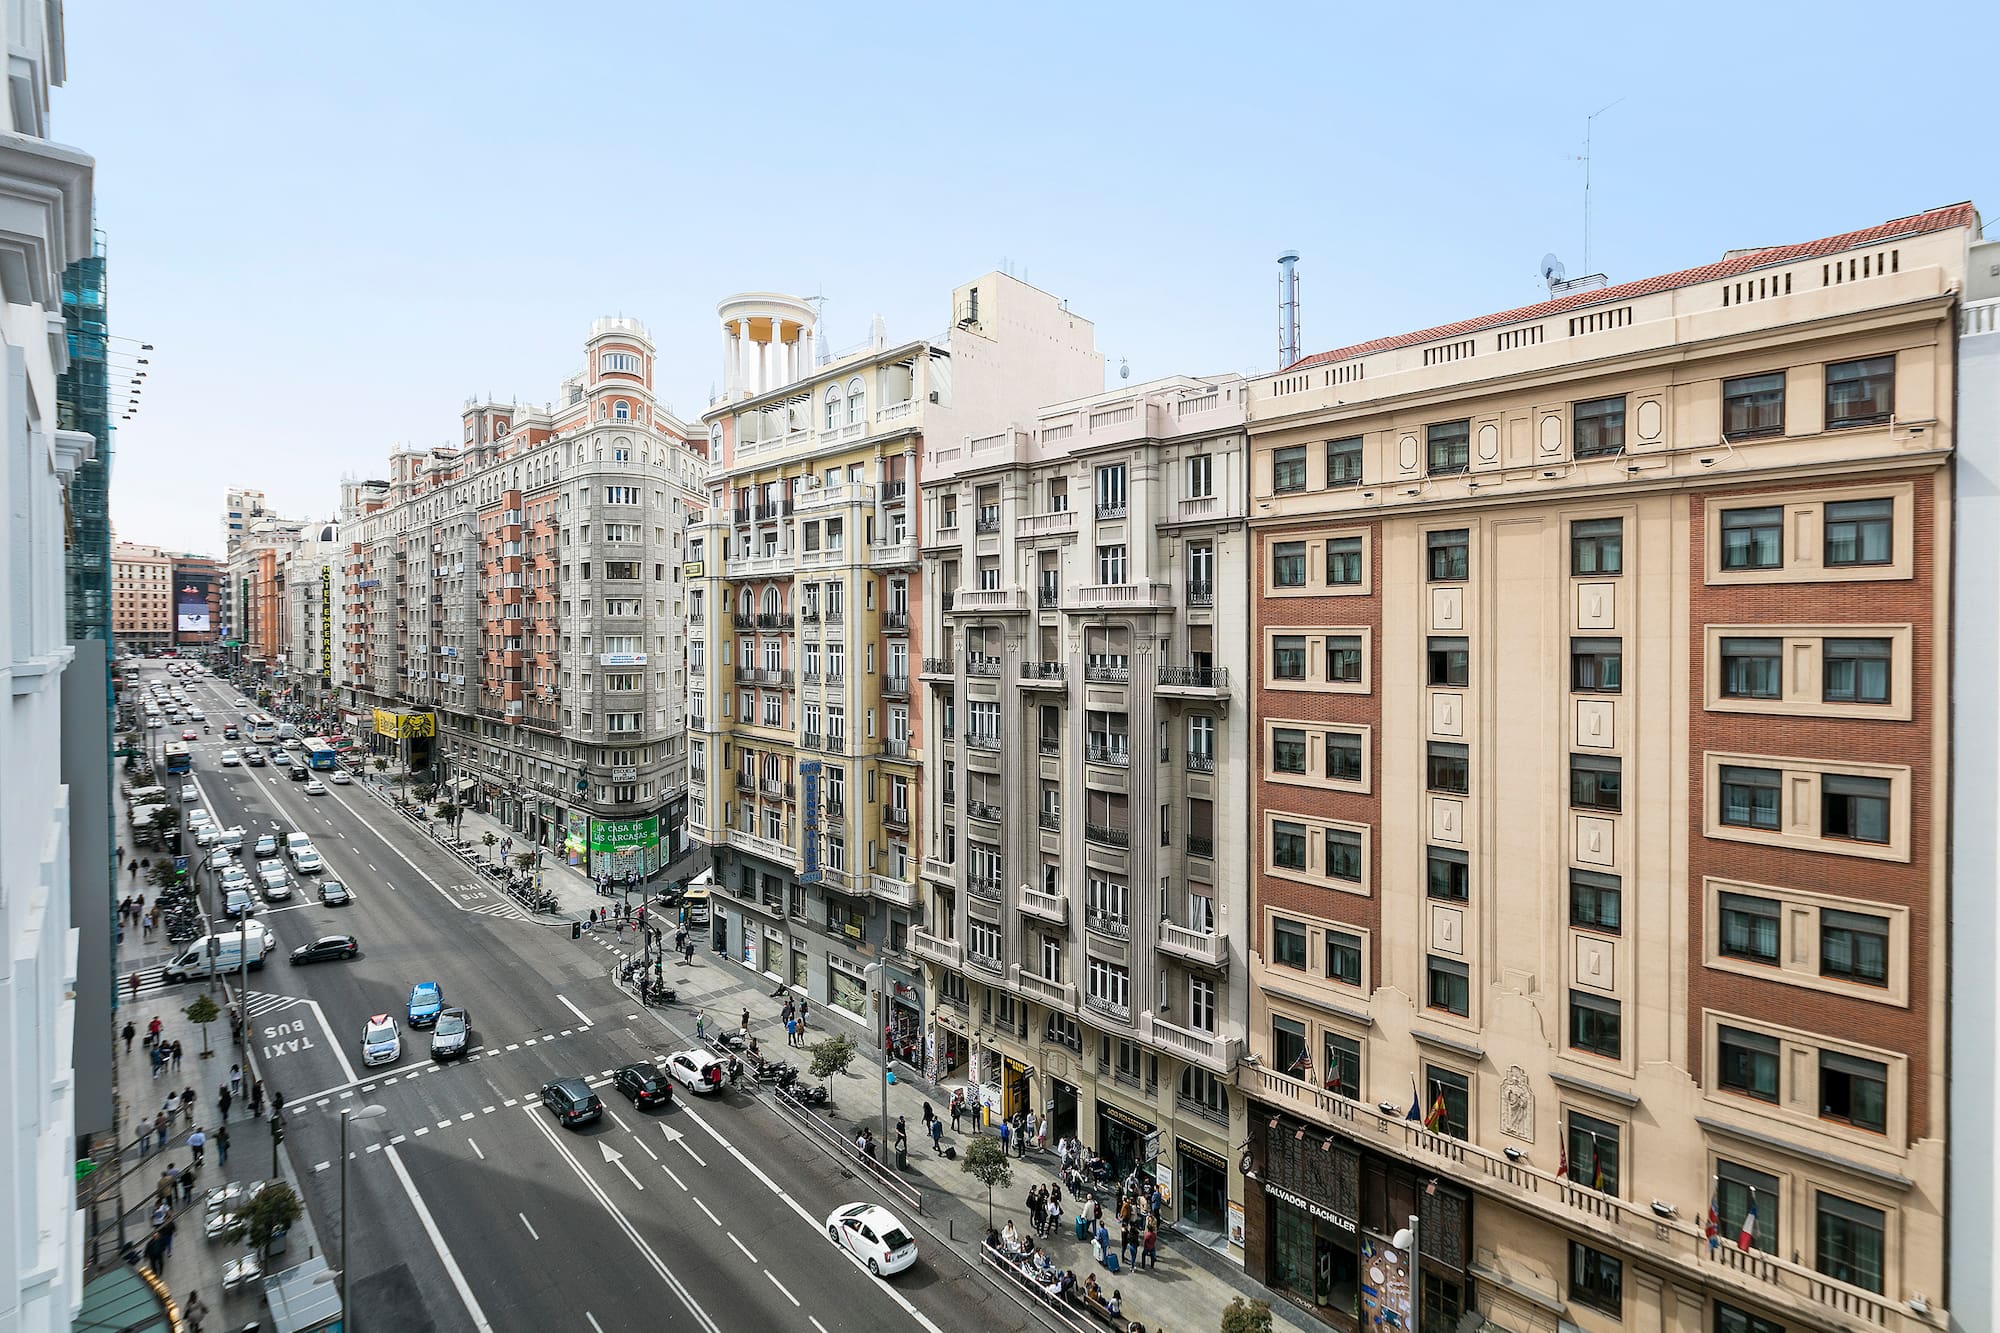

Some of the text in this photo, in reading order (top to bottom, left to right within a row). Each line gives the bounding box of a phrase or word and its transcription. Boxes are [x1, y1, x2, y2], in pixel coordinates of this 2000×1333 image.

[607, 824, 629, 833] CASA
[632, 823, 643, 831] DE
[806, 775, 816, 871] BUENOS AIRES
[607, 831, 648, 842] CARCASAS
[800, 873, 821, 884] HOSTAL
[450, 883, 482, 891] TAXI
[460, 892, 487, 900] BUS
[263, 1019, 305, 1039] BUS
[263, 1036, 315, 1059] TAXI
[1264, 1183, 1356, 1234] SALVADOR BACHILLER
